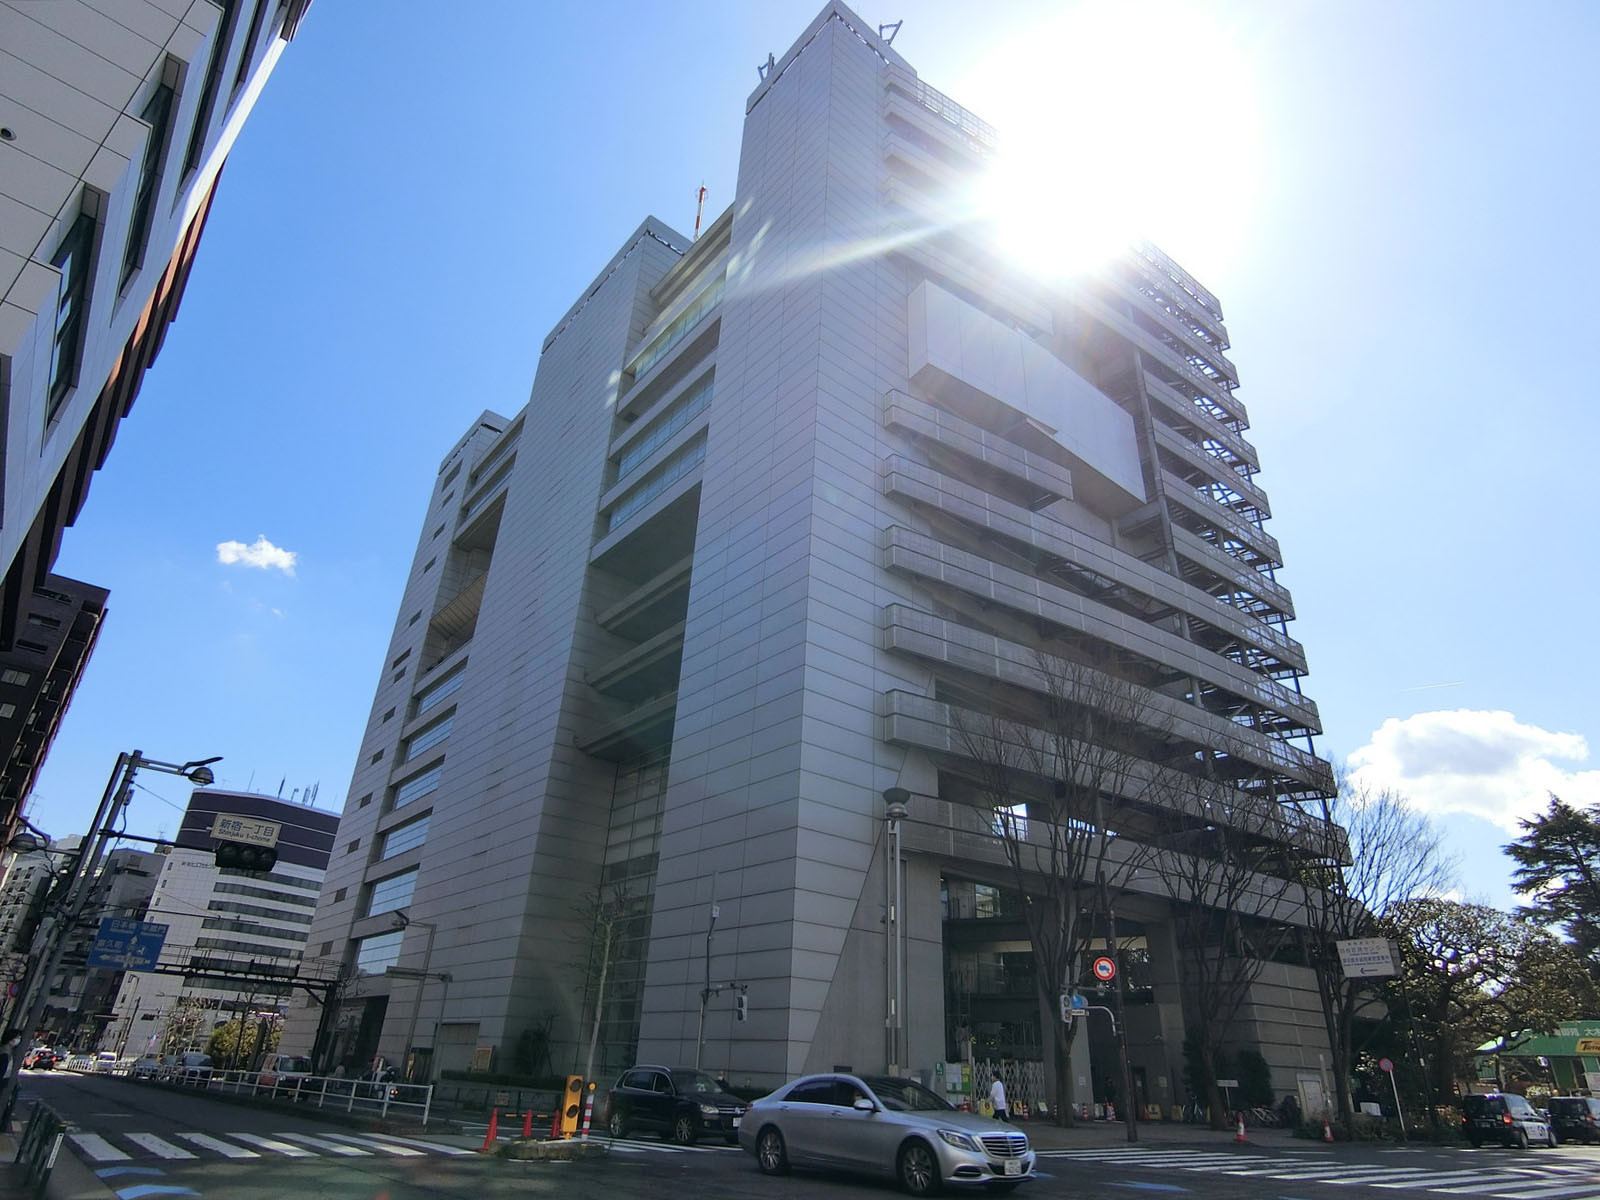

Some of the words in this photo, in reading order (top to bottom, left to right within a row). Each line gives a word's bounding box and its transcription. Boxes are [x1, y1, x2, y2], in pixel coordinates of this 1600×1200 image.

[218, 828, 244, 839] Shinjuku
[220, 818, 275, 837] 新宿一丁目
